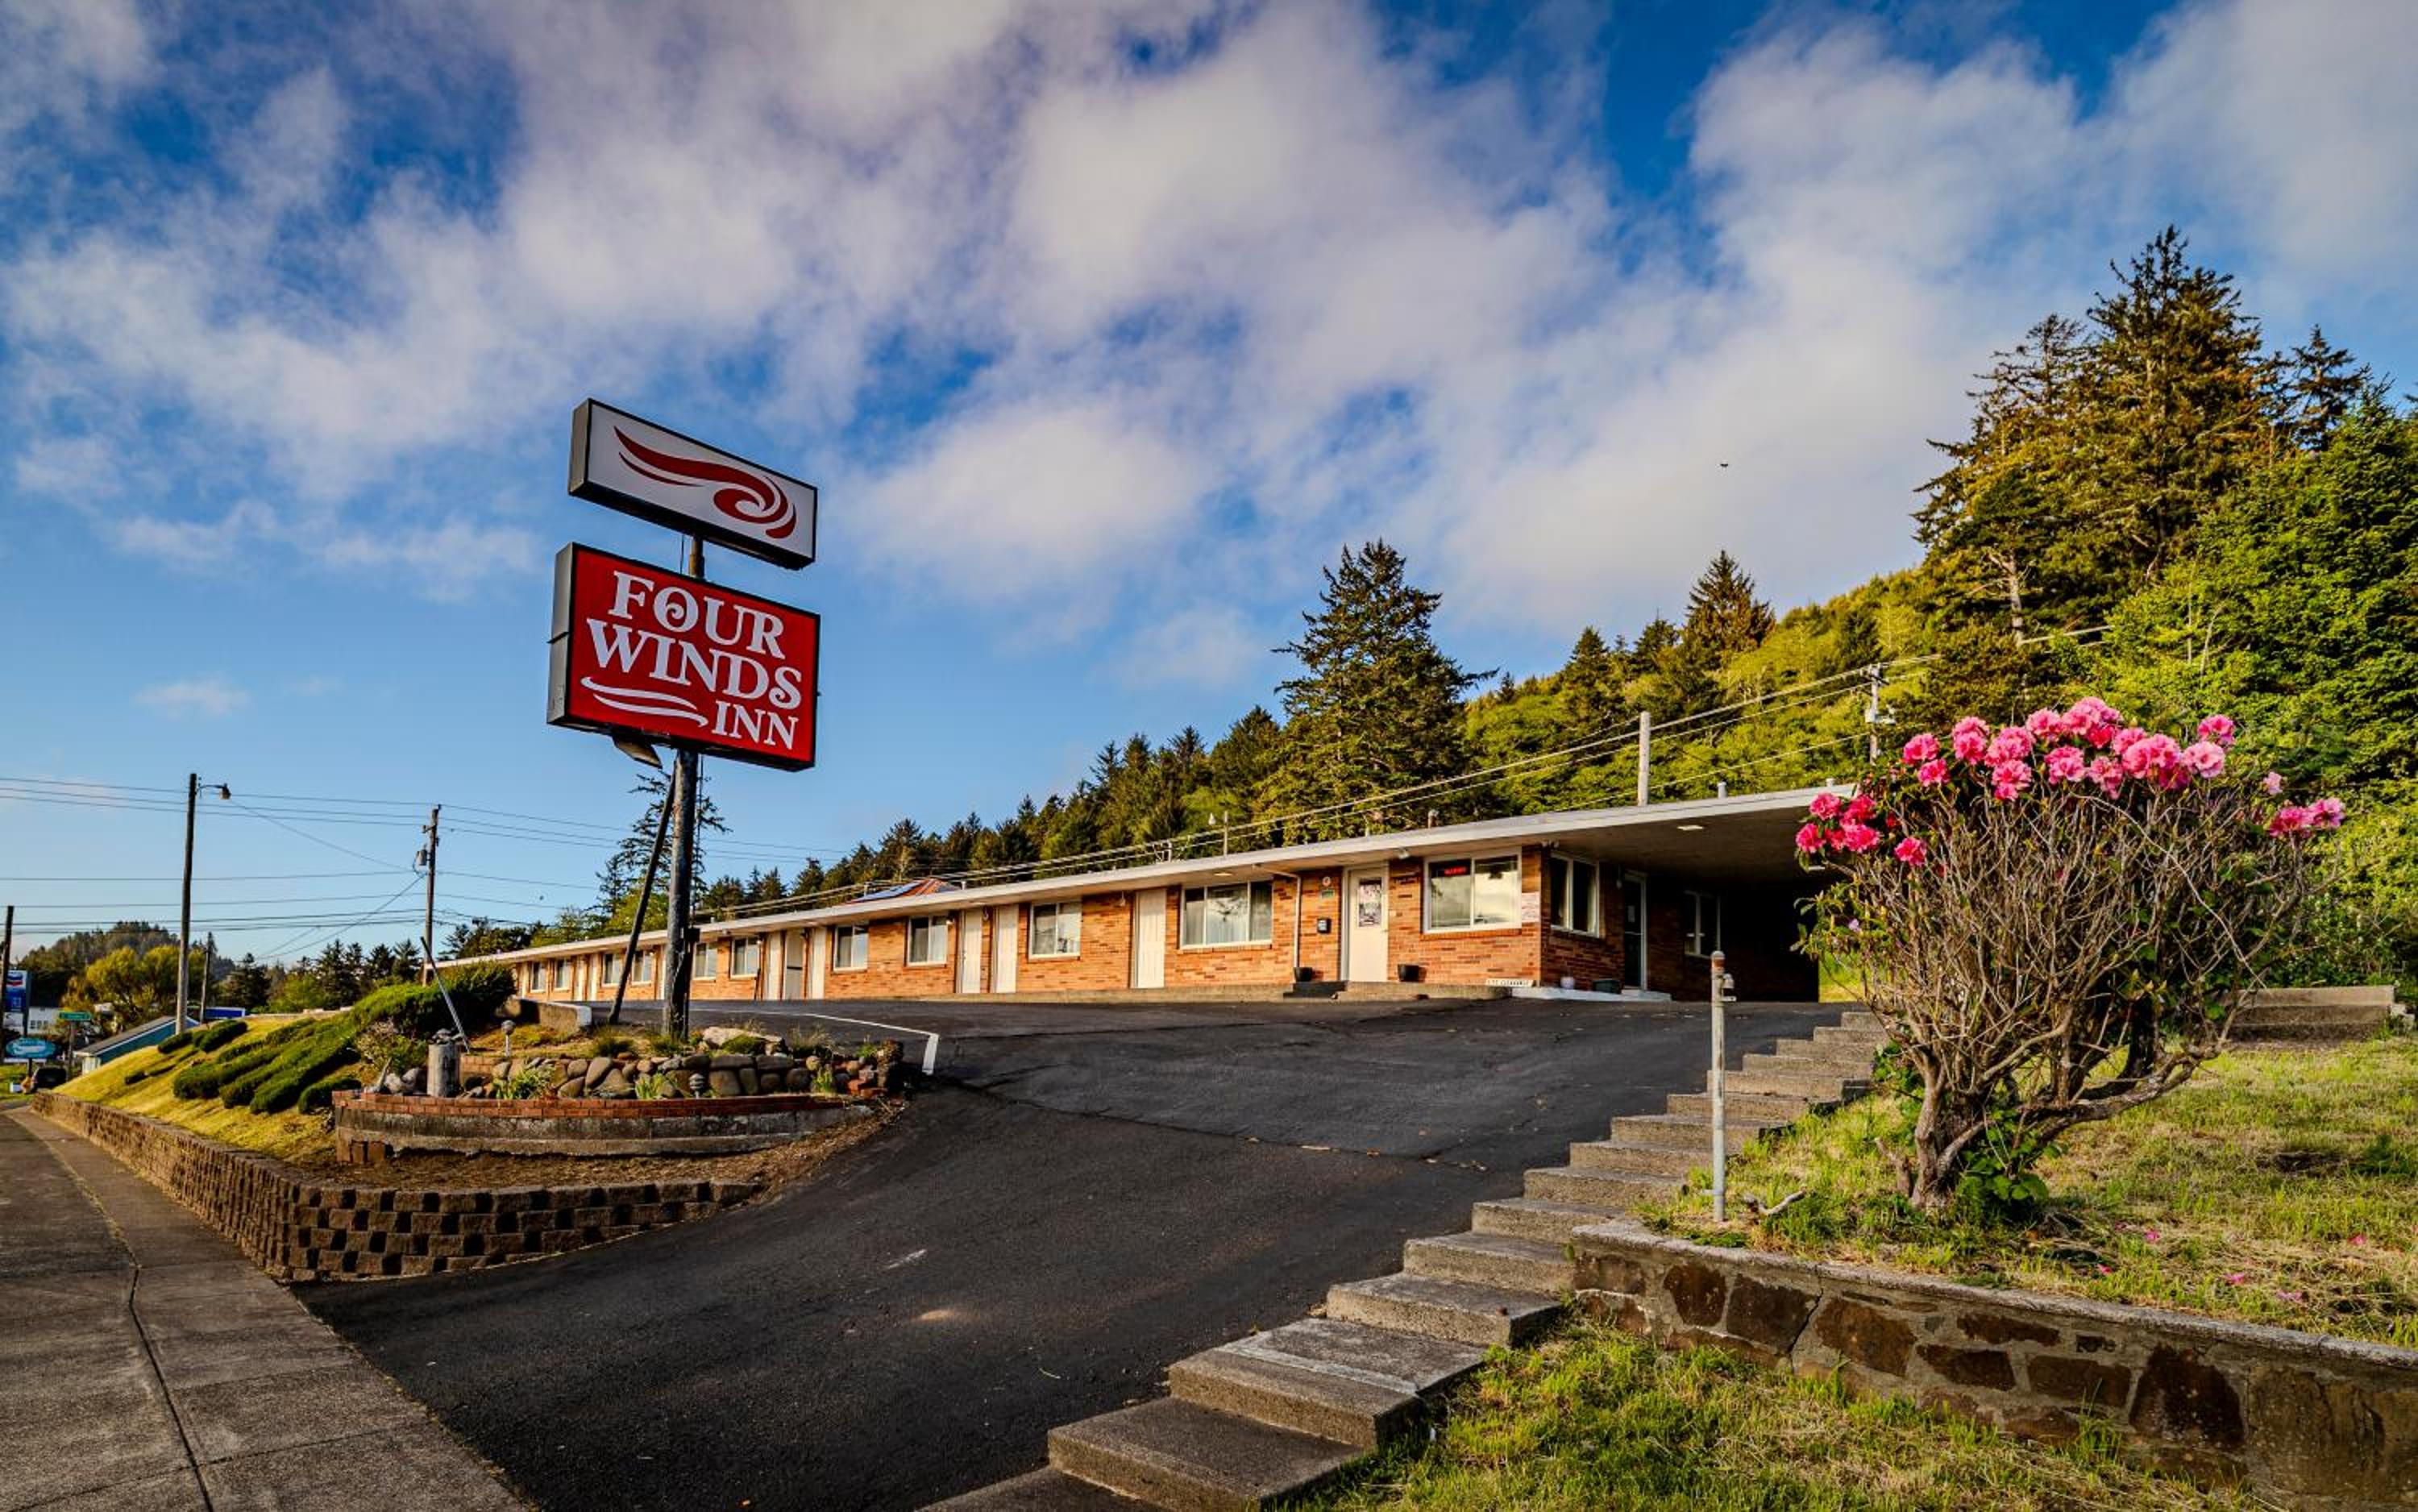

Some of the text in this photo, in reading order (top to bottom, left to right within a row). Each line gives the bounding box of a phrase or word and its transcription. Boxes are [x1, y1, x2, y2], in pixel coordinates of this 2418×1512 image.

[607, 570, 786, 659] FOUR
[586, 617, 803, 710] WINDS
[711, 700, 800, 750] INN
